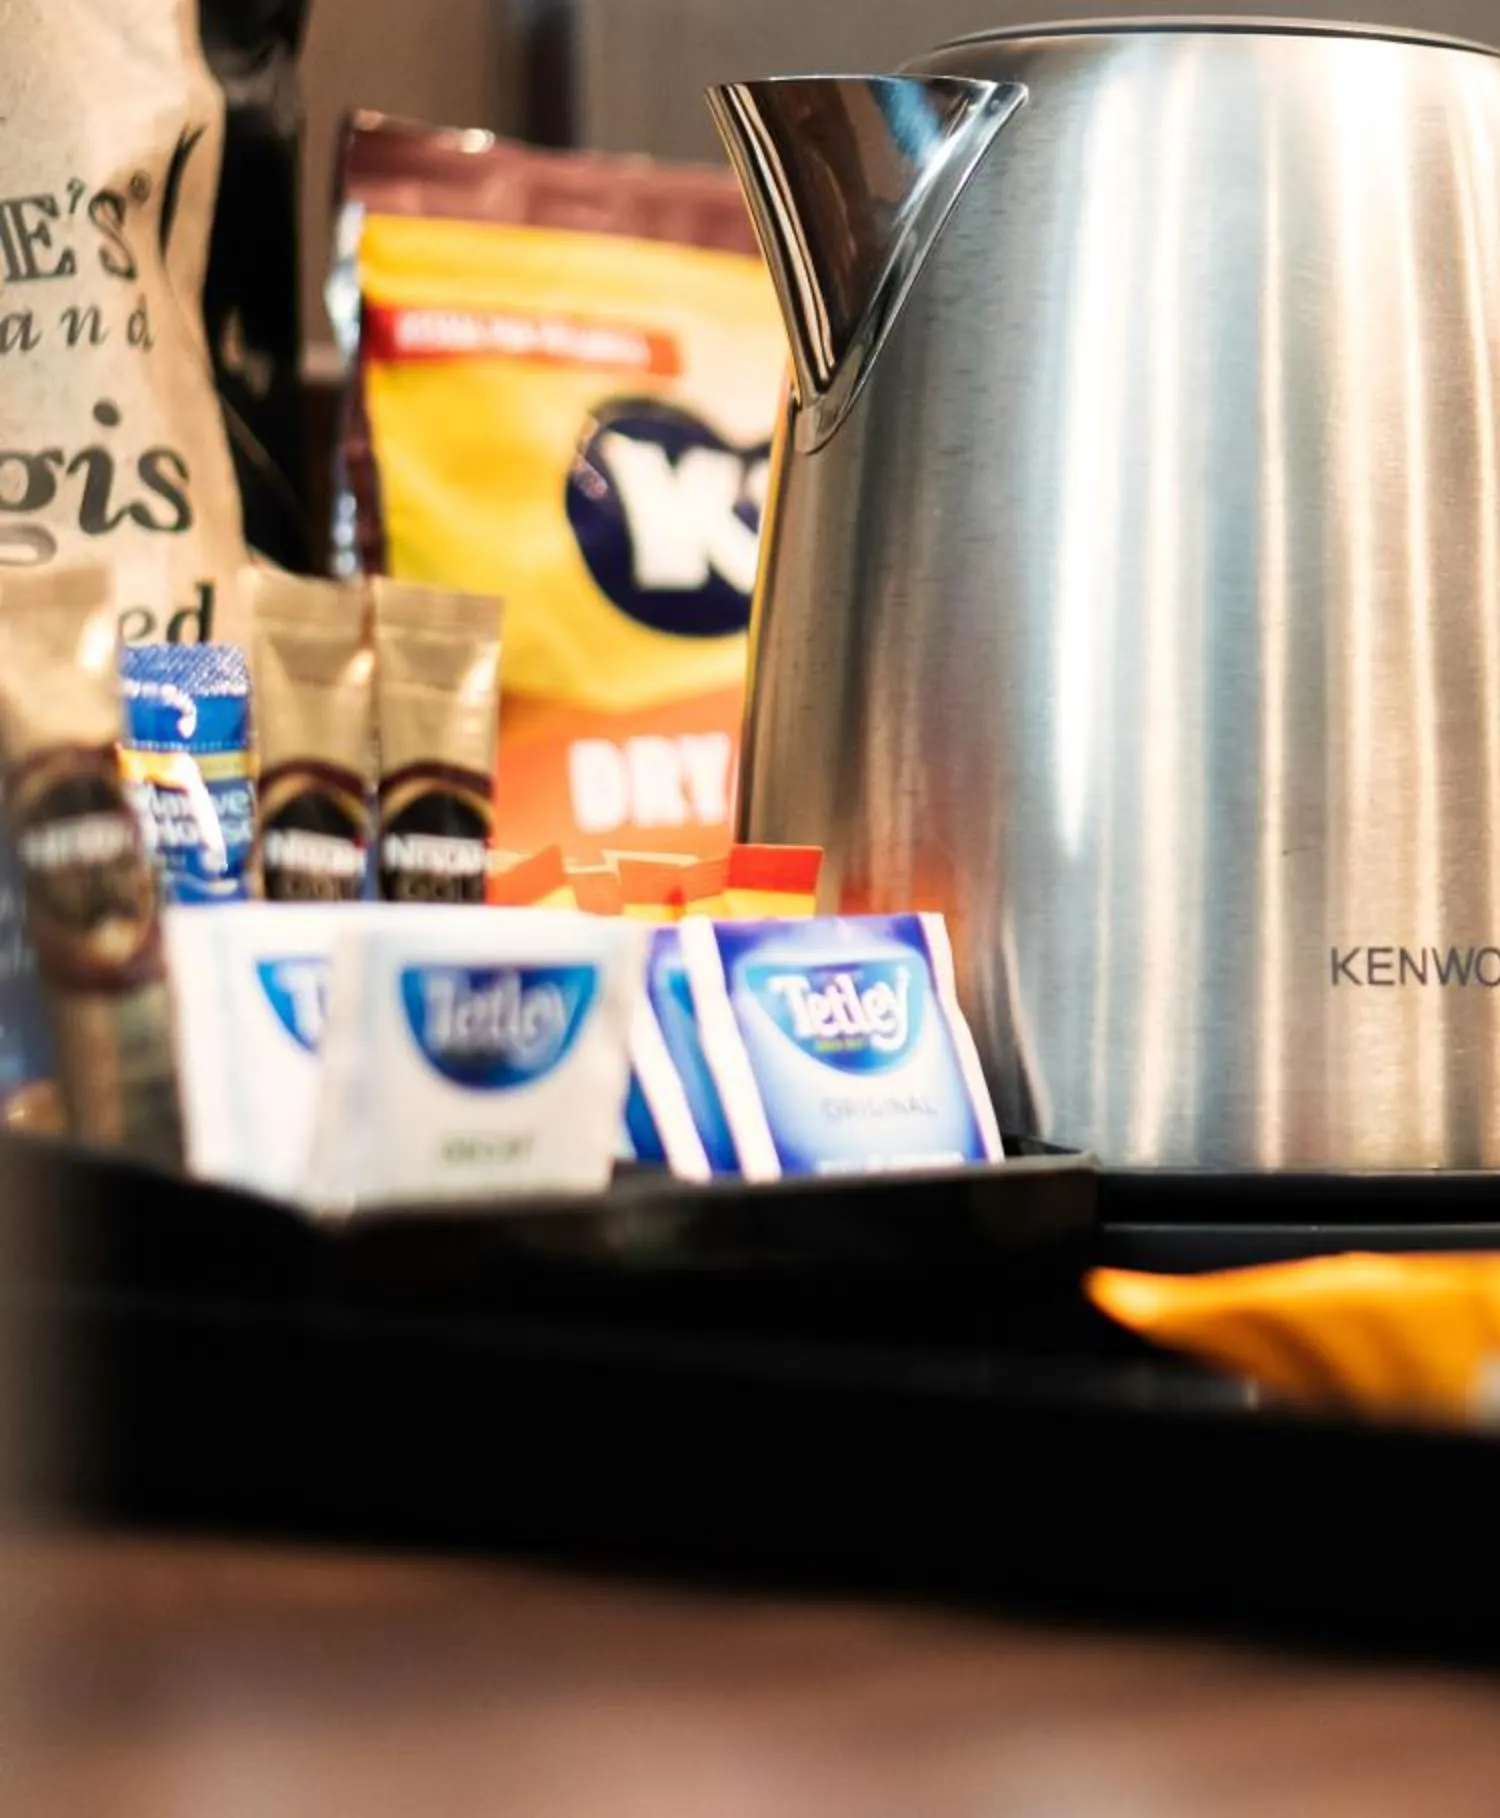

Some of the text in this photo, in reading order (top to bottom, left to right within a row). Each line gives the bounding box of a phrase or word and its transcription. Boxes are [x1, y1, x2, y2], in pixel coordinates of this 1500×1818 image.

[568, 733, 732, 833] DRY
[424, 966, 582, 1071] Tetley
[767, 963, 910, 1051] Tetley
